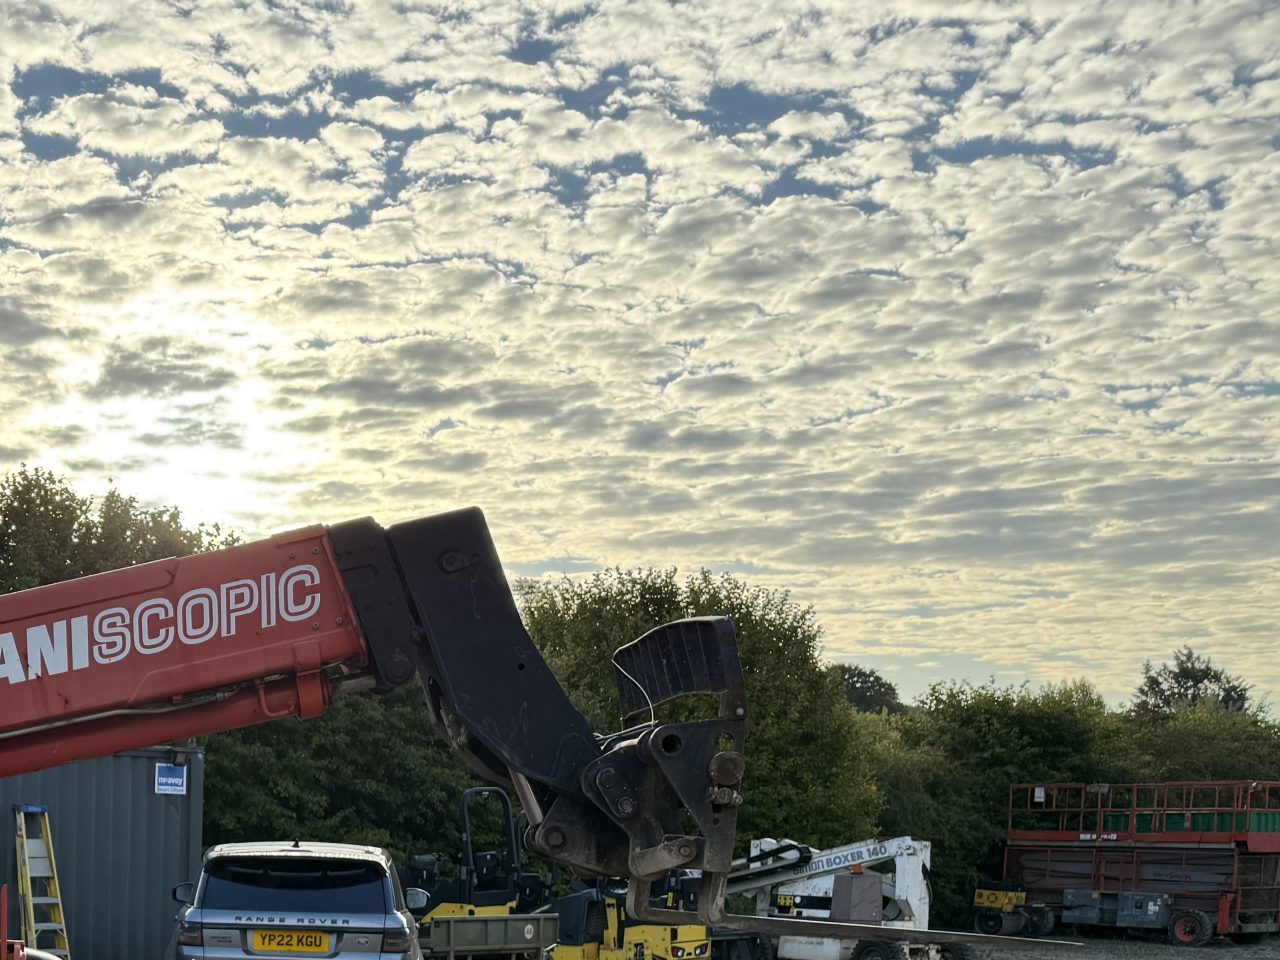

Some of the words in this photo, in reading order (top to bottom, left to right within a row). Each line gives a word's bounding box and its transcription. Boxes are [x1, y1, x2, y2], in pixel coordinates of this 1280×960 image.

[825, 850, 865, 868] BOXER
[866, 845, 888, 858] 140
[234, 915, 286, 923] RANGE
[260, 933, 293, 947] YP22
[296, 934, 323, 948] KGU
